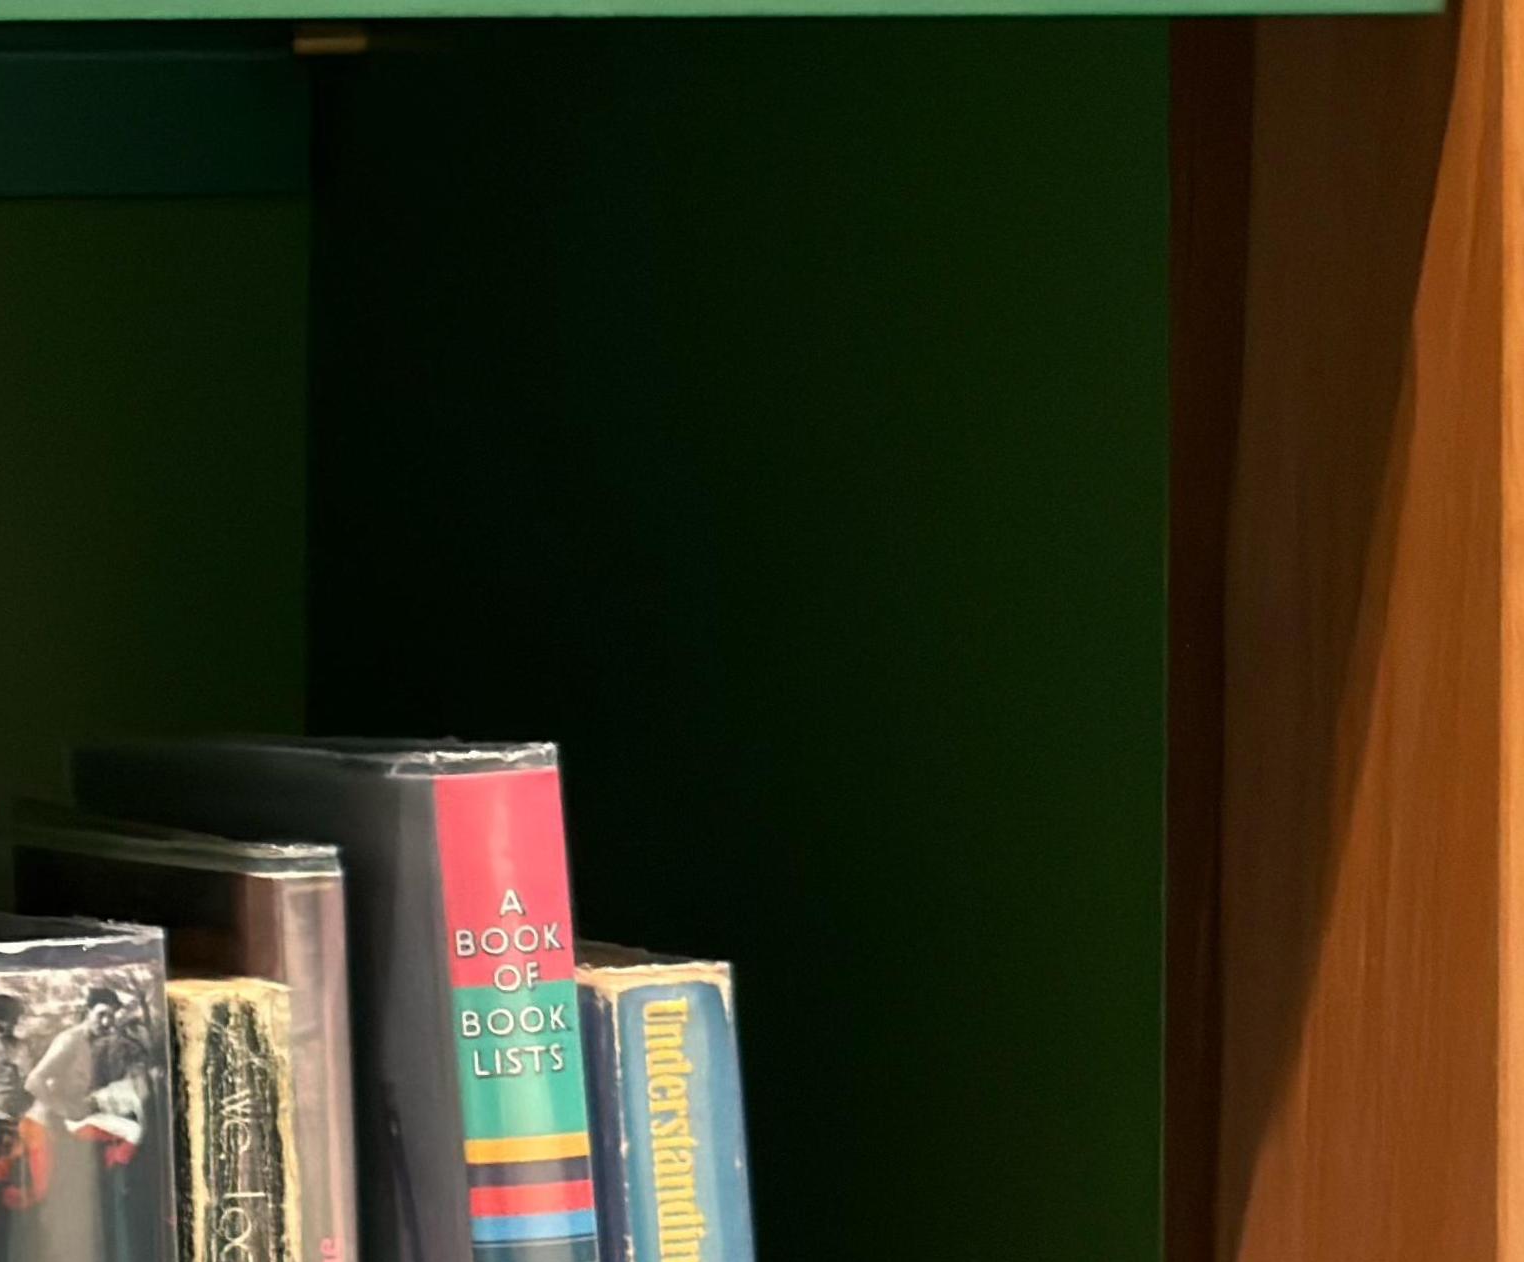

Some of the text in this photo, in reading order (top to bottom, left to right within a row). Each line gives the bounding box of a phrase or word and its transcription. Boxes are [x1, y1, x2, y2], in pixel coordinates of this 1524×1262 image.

[500, 889, 523, 916] A
[455, 923, 562, 956] BOOK
[495, 962, 540, 992] OF
[462, 1006, 568, 1038] BOOK
[473, 1045, 565, 1077] LISTS
